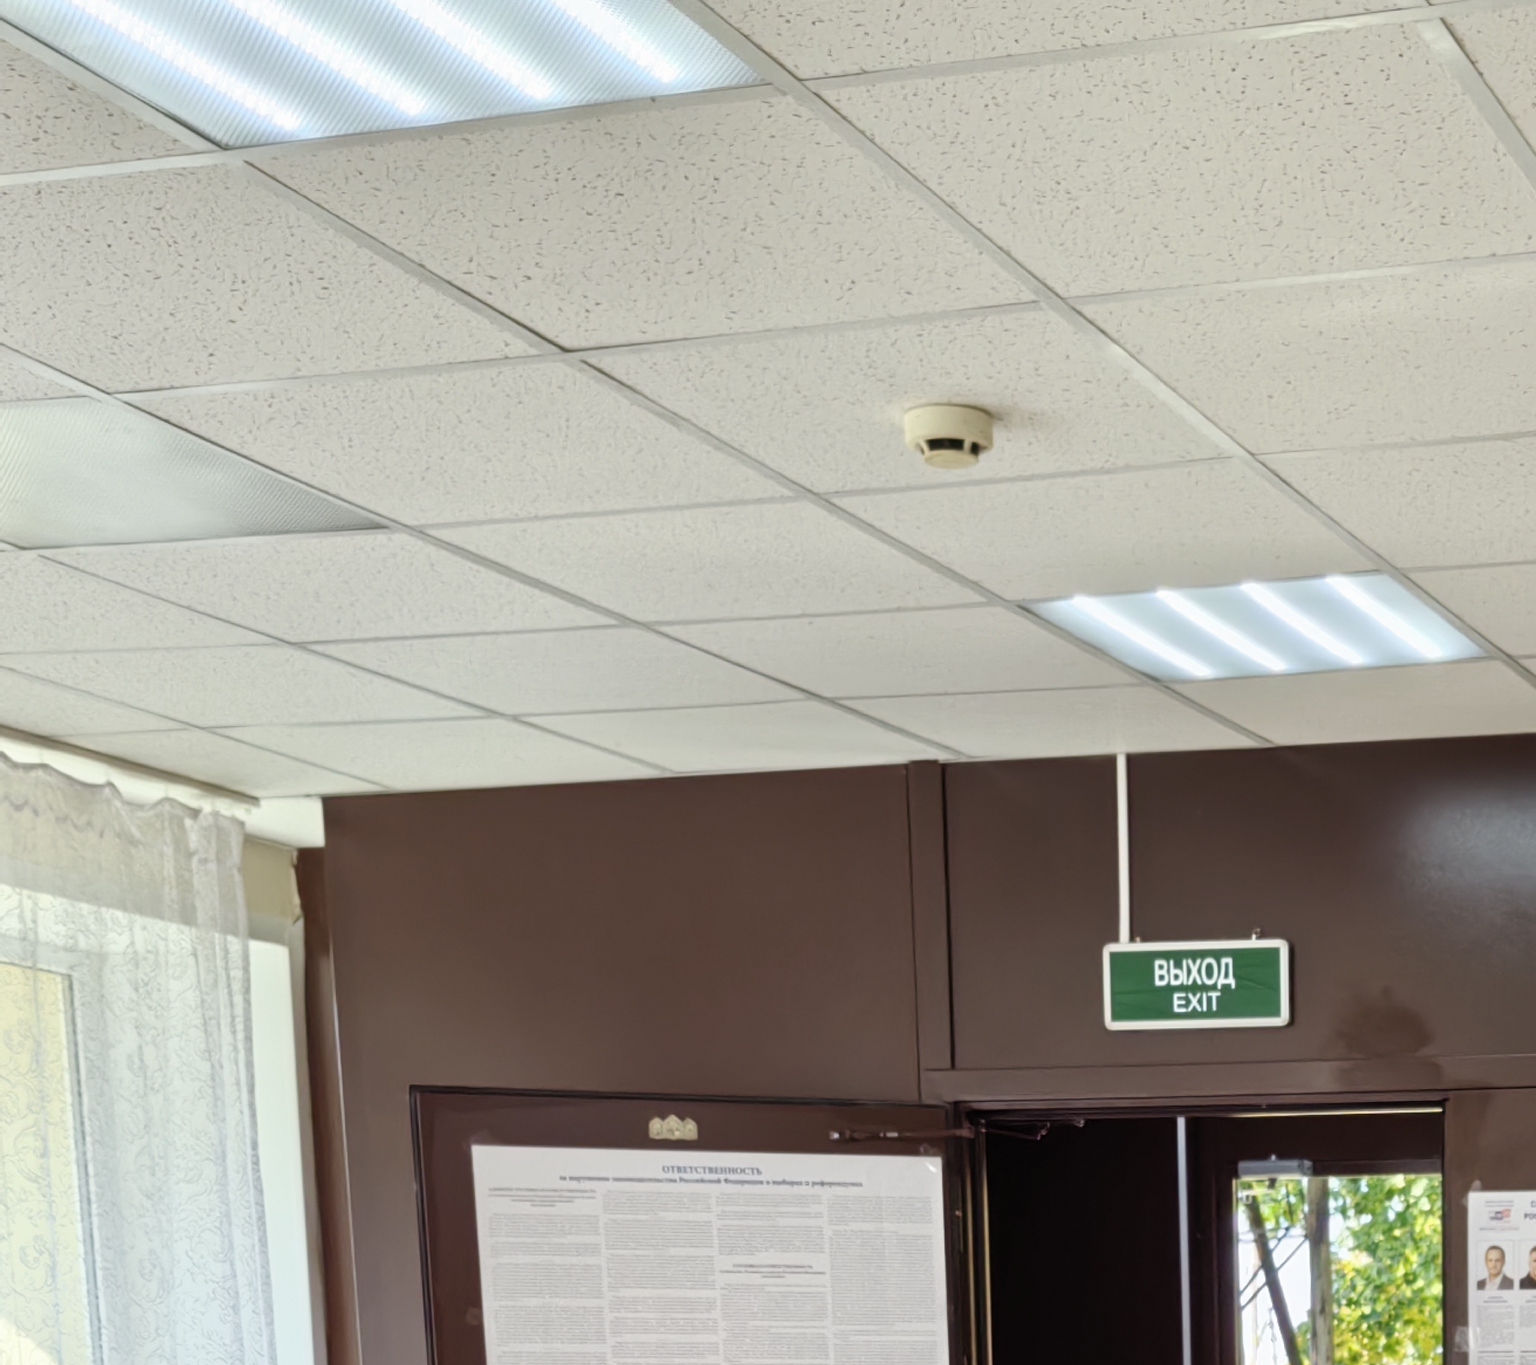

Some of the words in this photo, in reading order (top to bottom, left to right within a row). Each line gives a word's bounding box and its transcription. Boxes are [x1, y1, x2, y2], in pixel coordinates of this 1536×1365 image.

[1154, 957, 1235, 989] ВЫХОД
[1173, 992, 1221, 1013] EXIT
[662, 1165, 762, 1177] ОТВЕТСТВЕННОСТЬ
